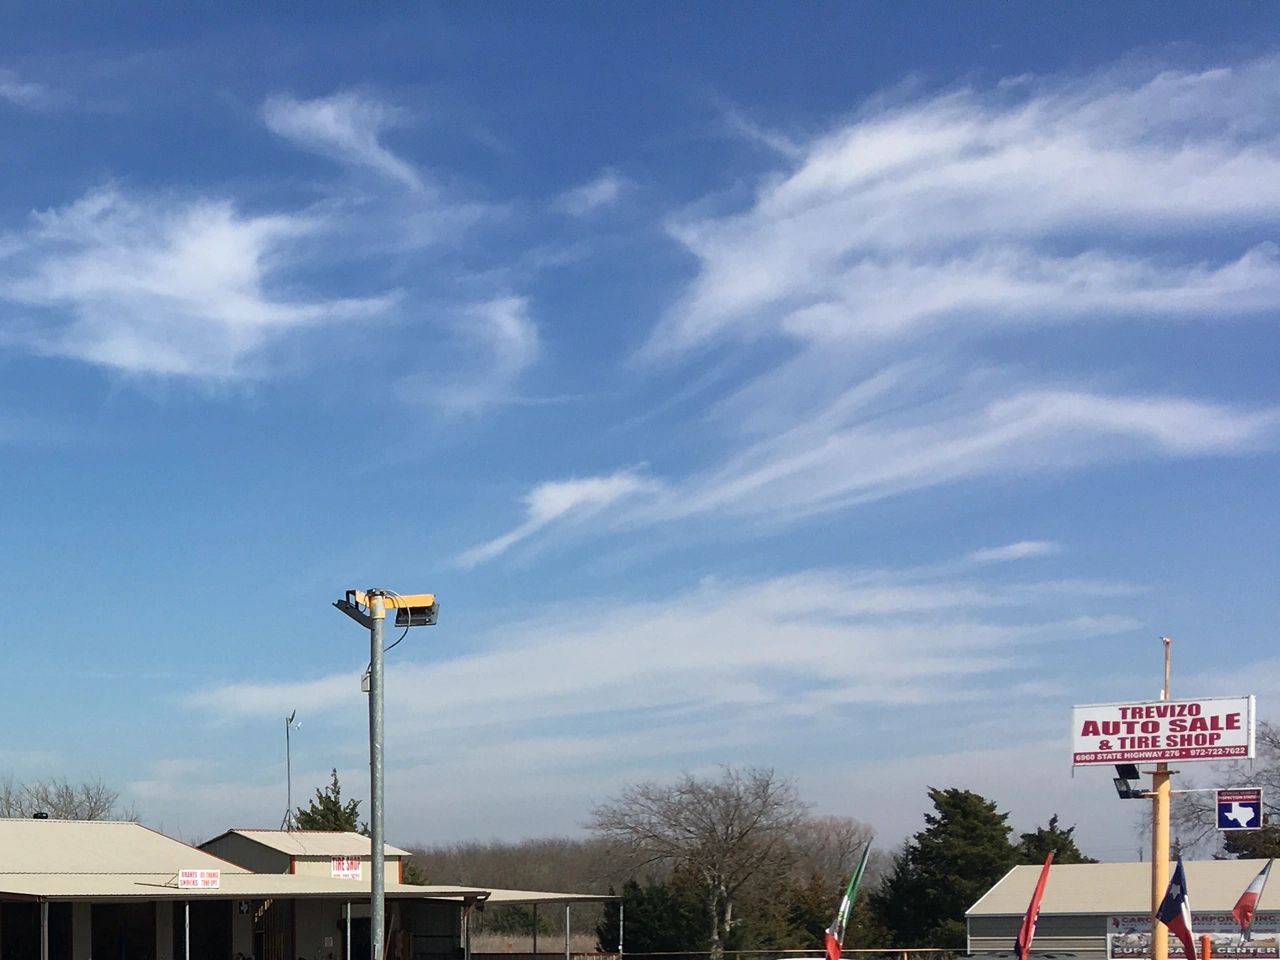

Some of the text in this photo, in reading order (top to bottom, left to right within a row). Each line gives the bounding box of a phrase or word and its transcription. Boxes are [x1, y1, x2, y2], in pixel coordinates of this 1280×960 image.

[1118, 703, 1201, 720] TREVIZO
[1081, 713, 1241, 737] AUTO SALE
[1098, 732, 1222, 750] & TIRE SHOP
[1097, 752, 1122, 760] STATE
[1124, 750, 1163, 759] HIGHWAY
[1165, 749, 1180, 758] 276
[1190, 746, 1246, 757] 972-722-7622
[332, 855, 361, 871] TIRE SHOP
